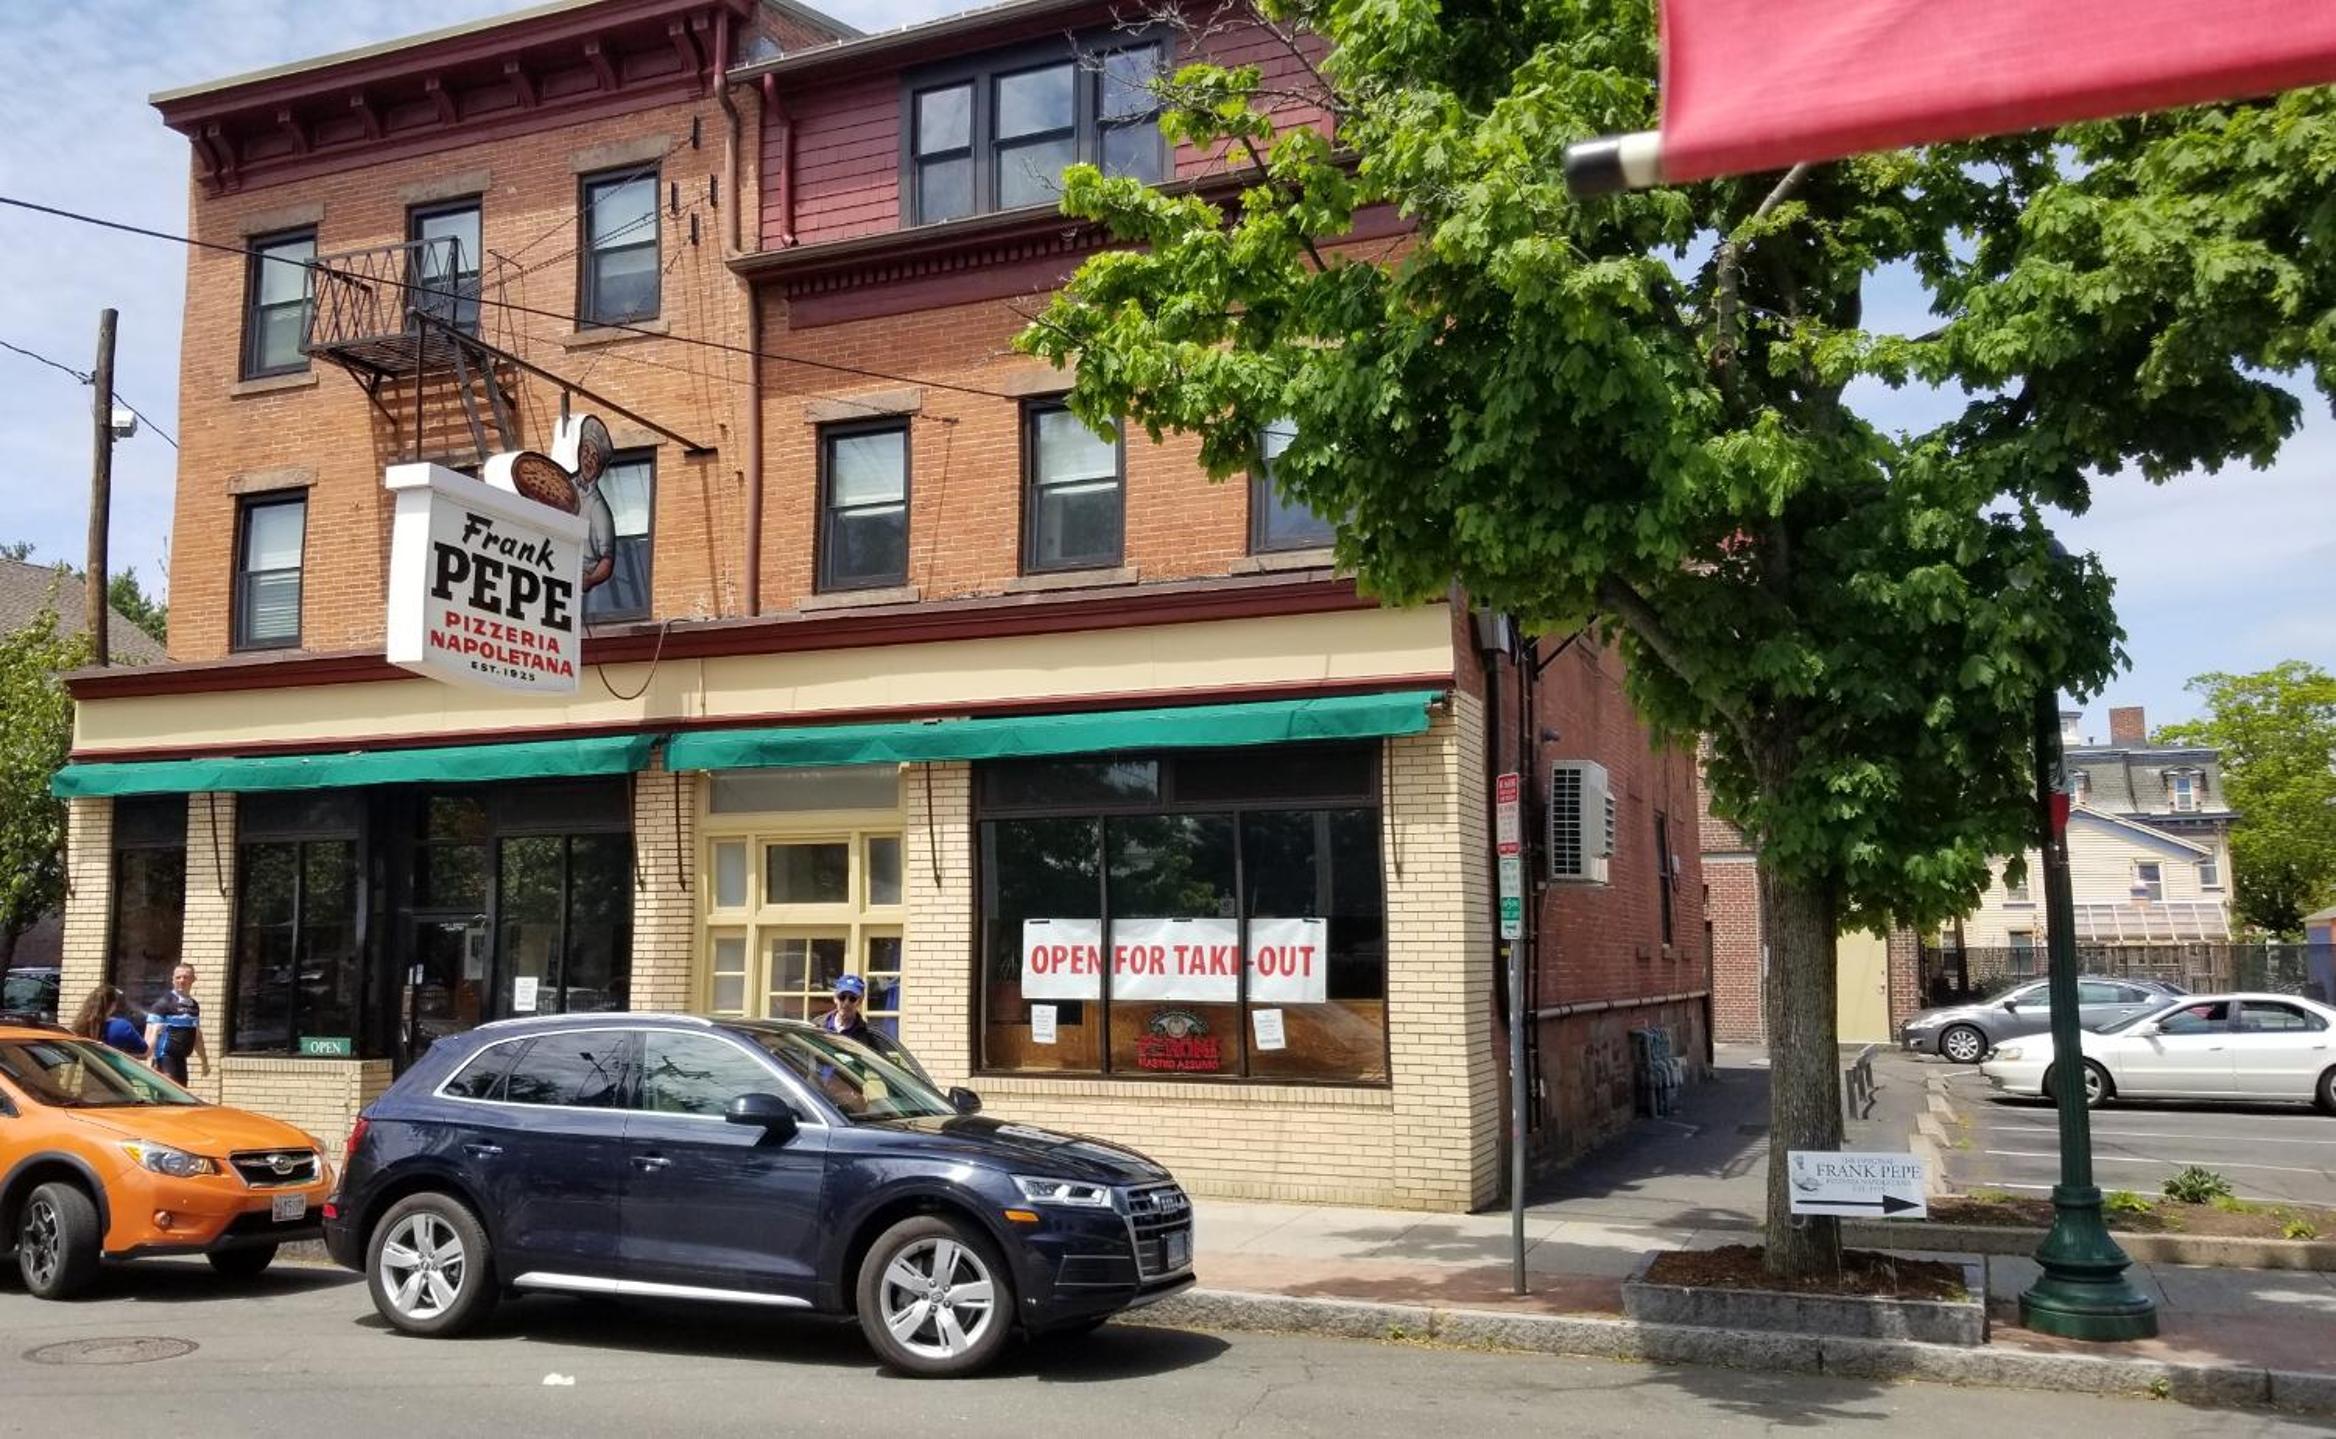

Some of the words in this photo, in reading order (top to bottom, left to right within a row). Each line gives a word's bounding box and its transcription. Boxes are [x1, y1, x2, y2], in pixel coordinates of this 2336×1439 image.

[462, 512, 555, 572] Frank
[431, 541, 572, 632] PEPE
[430, 629, 573, 677] NAPOLETANA
[445, 611, 560, 653] PIZZERIA
[1031, 944, 1105, 974] OPEN
[1114, 945, 1166, 975] FOR
[310, 1041, 341, 1054] OPEN
[1816, 1164, 1876, 1178] FRANK
[1881, 1165, 1920, 1179] PEPE
